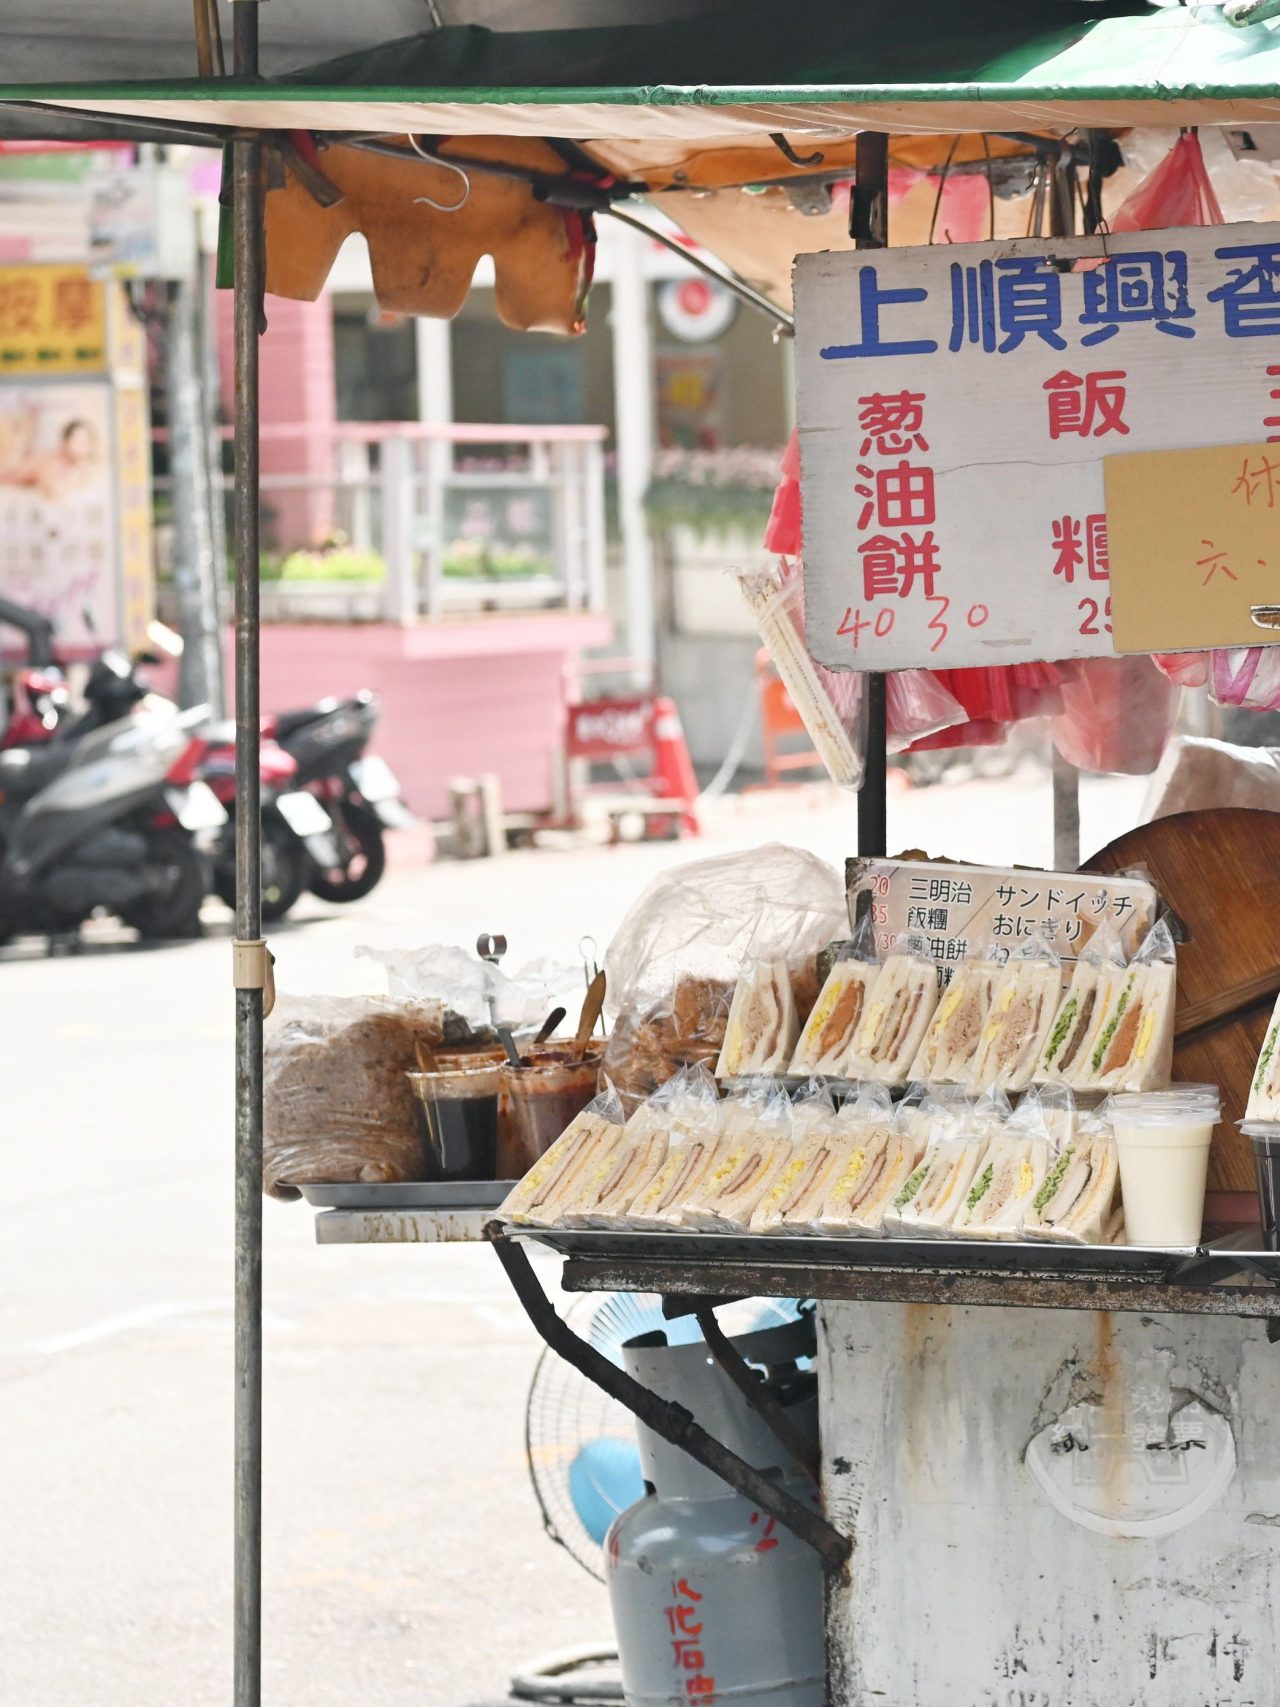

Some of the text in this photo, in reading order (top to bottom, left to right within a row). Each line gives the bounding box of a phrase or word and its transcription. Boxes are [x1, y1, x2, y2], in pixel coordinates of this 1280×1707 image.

[836, 606, 896, 649] 40
[870, 876, 890, 896] 20
[909, 878, 972, 905] 三明治
[996, 885, 1133, 917] サンドイッチ
[992, 914, 1083, 942] おにぎり
